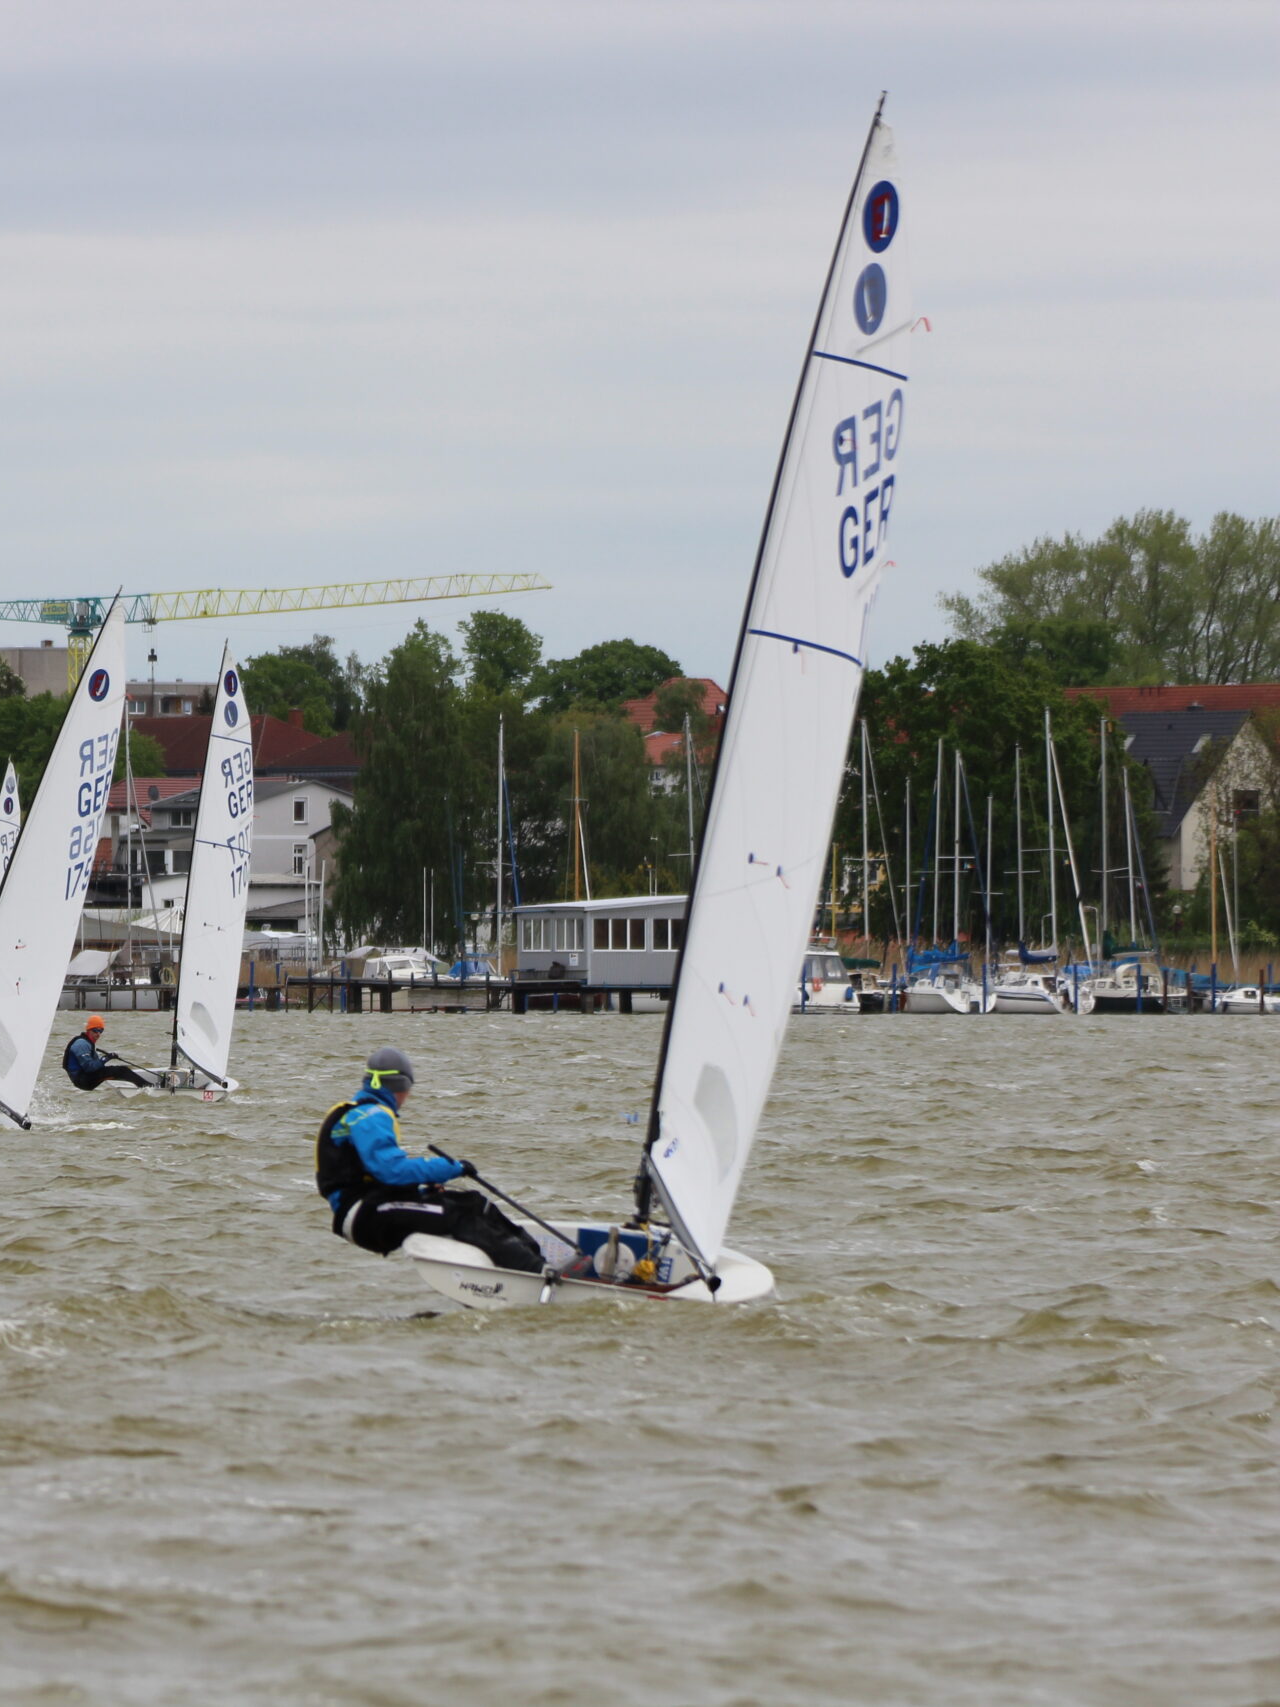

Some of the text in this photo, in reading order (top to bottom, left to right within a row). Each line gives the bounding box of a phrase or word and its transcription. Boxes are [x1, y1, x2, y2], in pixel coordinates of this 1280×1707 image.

[838, 474, 895, 578] GER
[227, 779, 253, 819] GER
[65, 857, 92, 901] 175
[230, 855, 251, 898] 170
